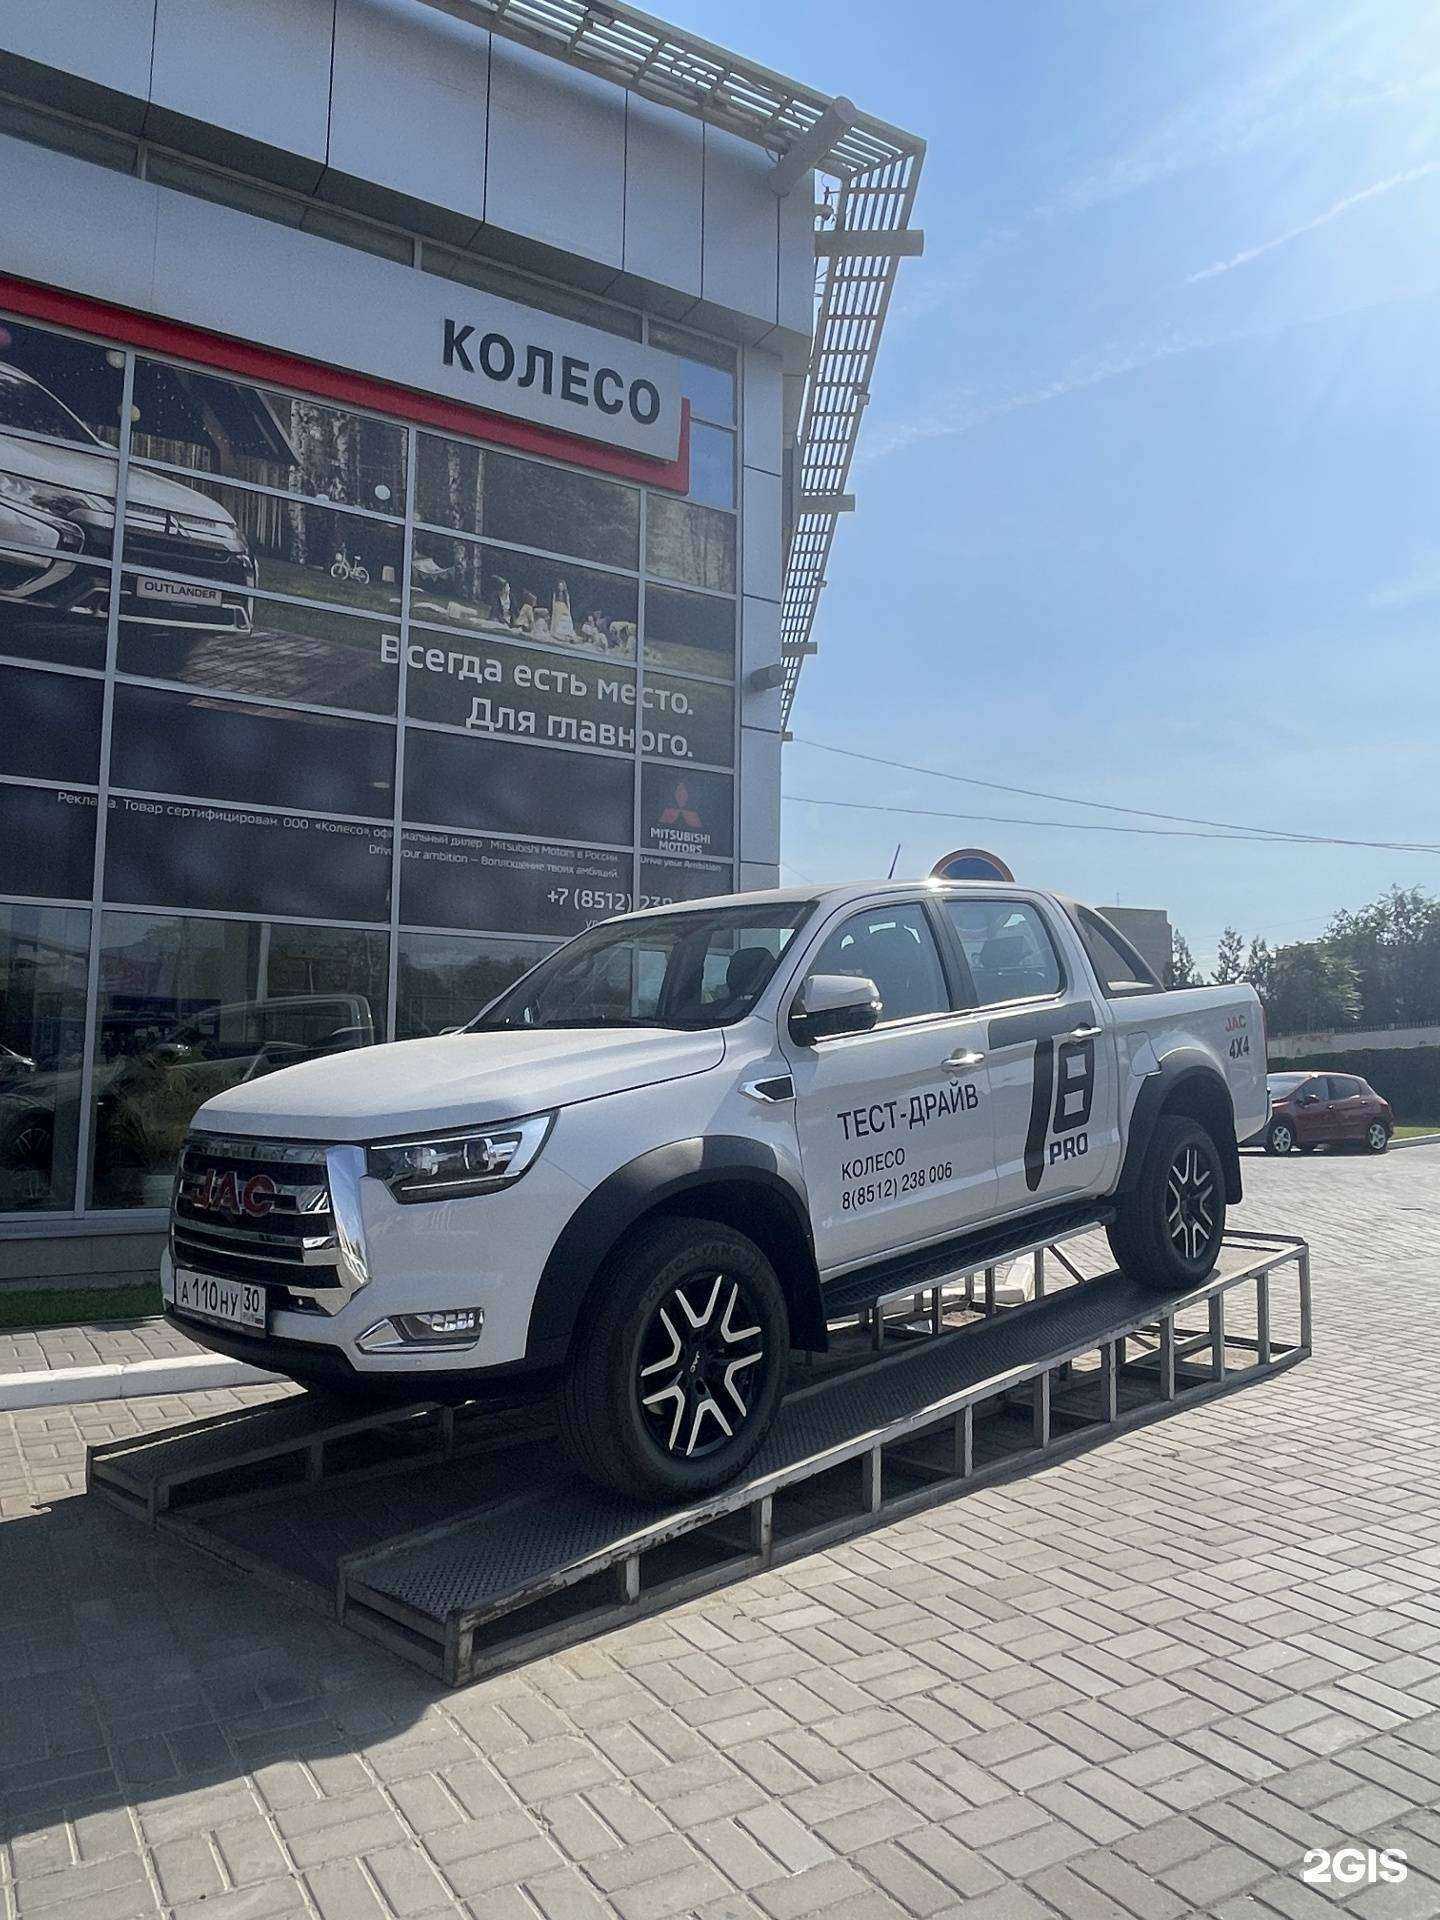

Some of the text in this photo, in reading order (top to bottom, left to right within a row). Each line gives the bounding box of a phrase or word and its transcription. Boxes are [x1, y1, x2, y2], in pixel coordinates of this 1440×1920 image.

[443, 318, 661, 425] КОЛЕСО
[144, 581, 217, 599] OUTLANDER
[380, 633, 694, 715] Всегда есть место.
[465, 696, 694, 757] Для главного.
[57, 791, 118, 809] Реклаа.
[123, 798, 163, 815] Товар
[283, 817, 309, 830] ООО
[650, 827, 711, 845] MITSUBISHI
[659, 840, 703, 855] MOTORS
[547, 887, 569, 905] +7
[574, 888, 632, 913] (8512)
[1225, 1014, 1247, 1032] JAC
[837, 1080, 978, 1140] ТЕСТ-ДРАЙВ
[841, 1148, 905, 1181] КОЛЕСО
[1050, 1132, 1088, 1166] PRO
[192, 1168, 277, 1217] JAC
[842, 1161, 952, 1212] 8(8512) 238 006
